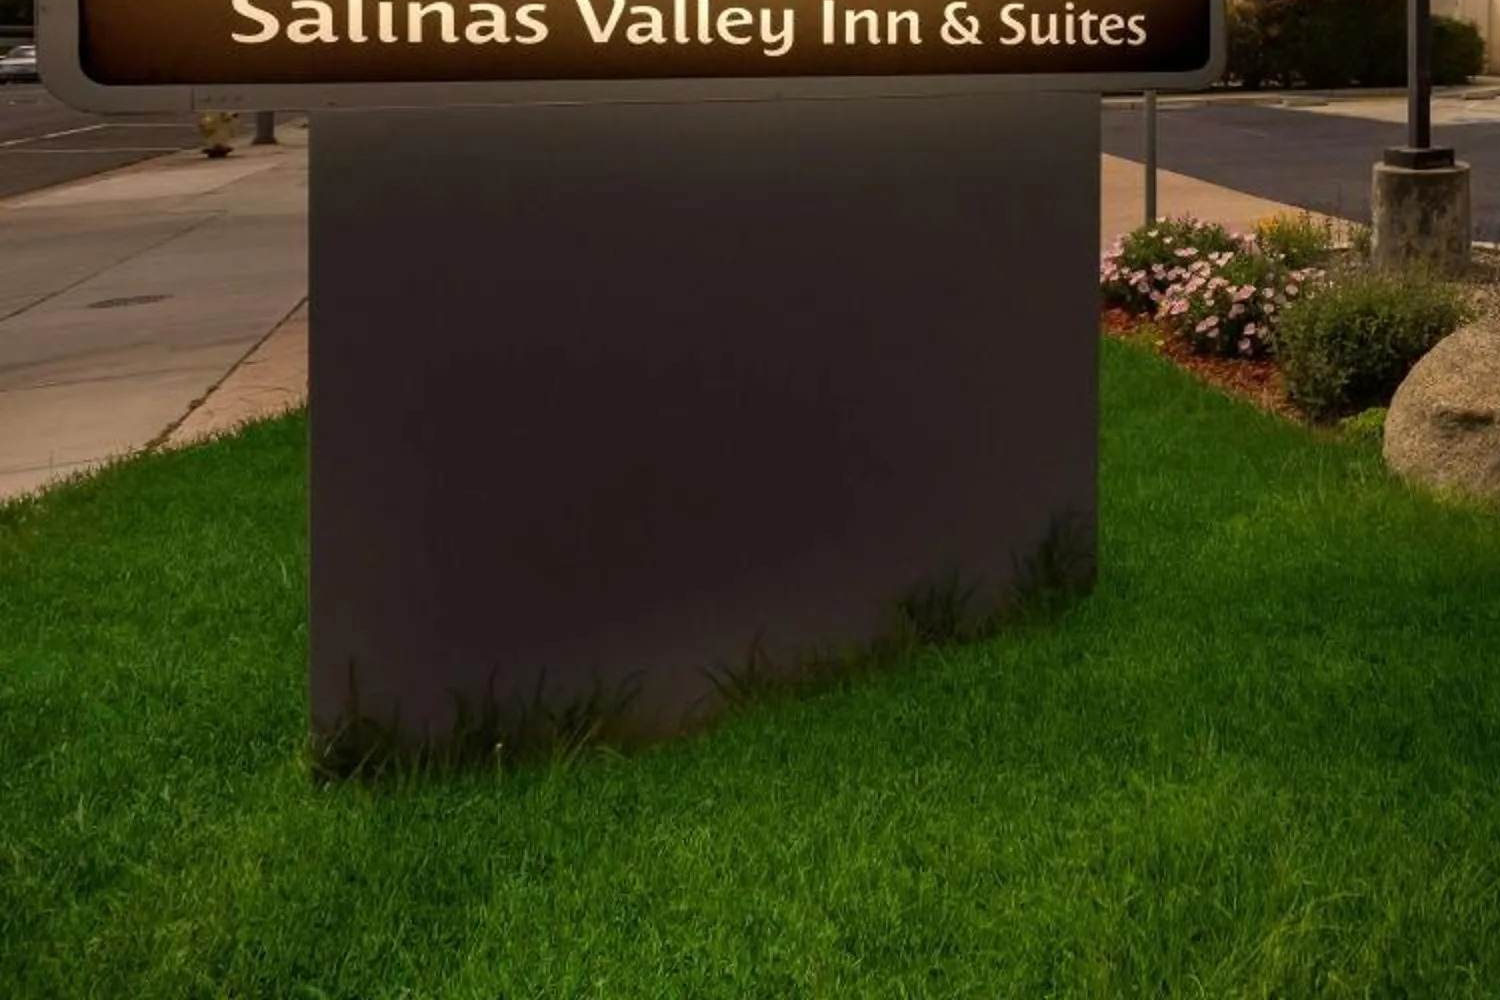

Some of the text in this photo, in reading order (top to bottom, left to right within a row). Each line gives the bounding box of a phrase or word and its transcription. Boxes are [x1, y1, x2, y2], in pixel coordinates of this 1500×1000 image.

[822, 0, 923, 45] Inn
[940, 1, 983, 45] &
[999, 3, 1147, 45] Suites
